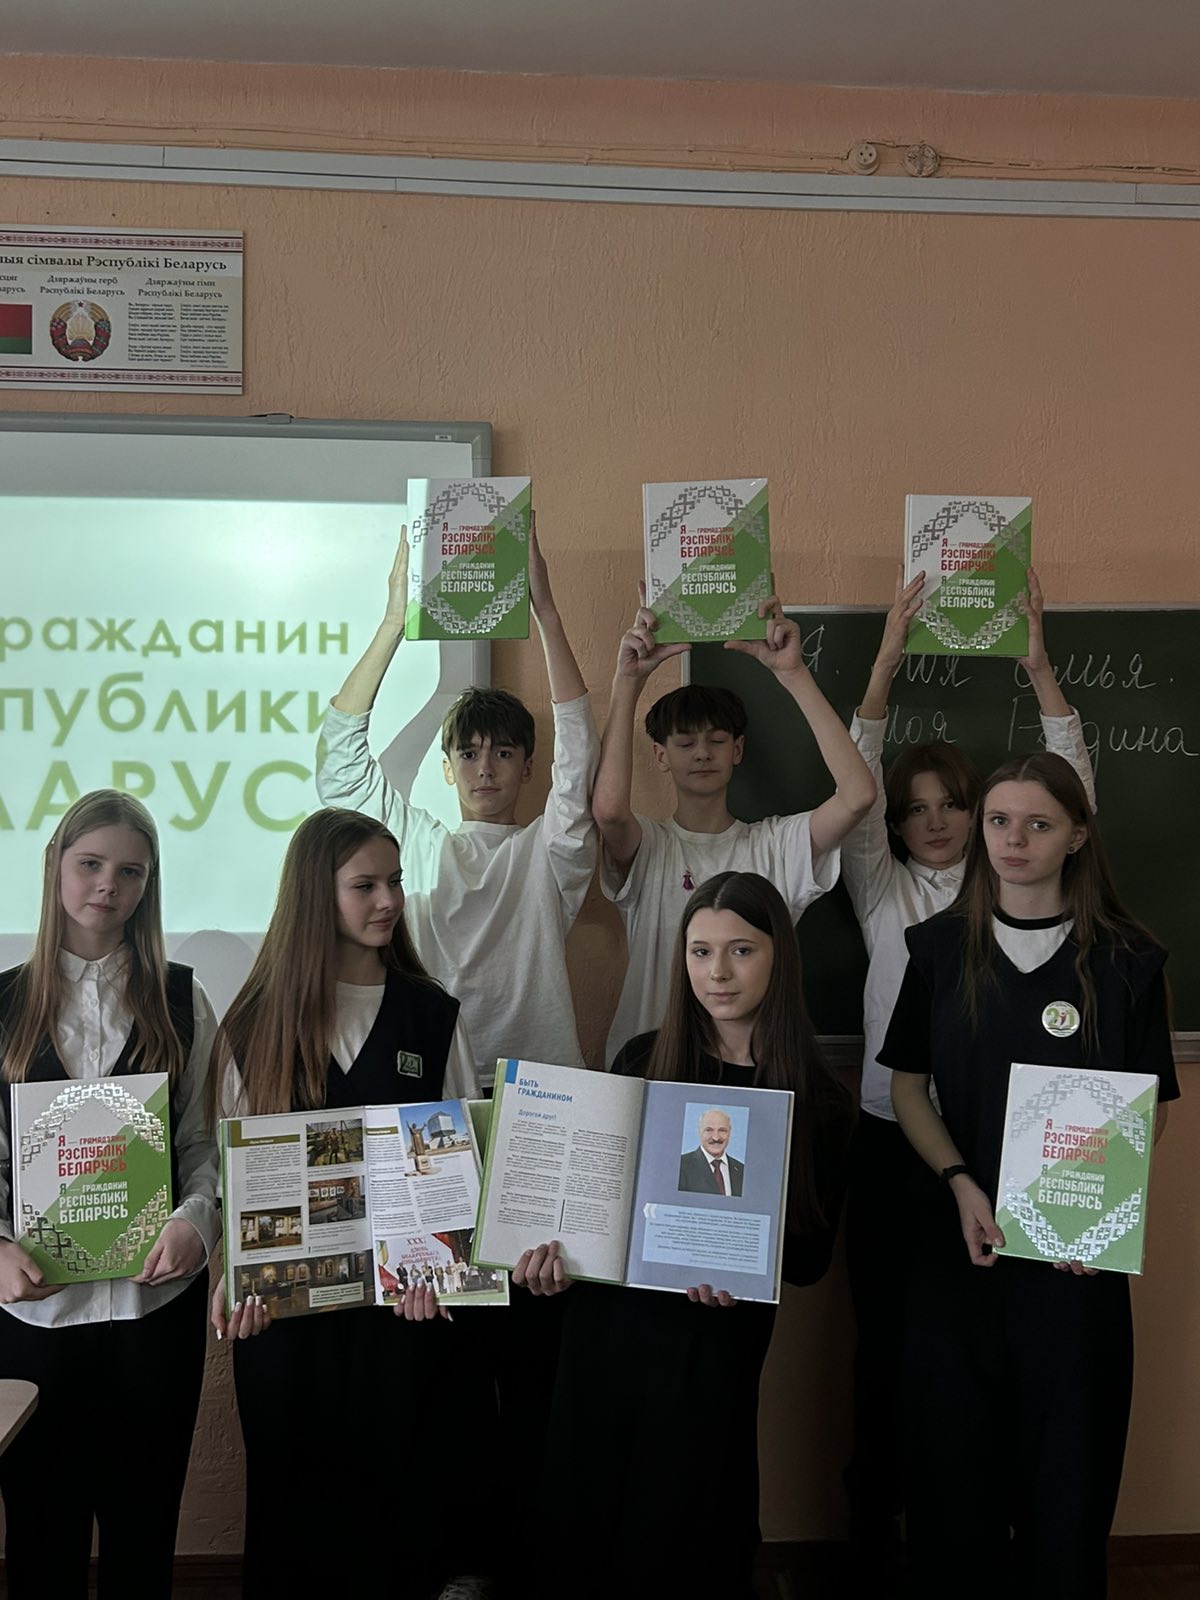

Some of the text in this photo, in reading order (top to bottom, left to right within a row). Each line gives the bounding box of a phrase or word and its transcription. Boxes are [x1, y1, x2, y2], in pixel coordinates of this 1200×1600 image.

[27, 254, 83, 268] сімвалы
[87, 255, 159, 271] Рэспублікі
[164, 257, 227, 272] Беларусь
[98, 276, 118, 285] герб
[40, 286, 125, 297] Рэспублікі Беларусь
[138, 289, 223, 300] Рэспублікі Беларусь
[442, 522, 449, 532] Я
[680, 525, 687, 535] Я
[941, 538, 948, 548] Я
[441, 544, 496, 556] БЕЛАРУСЬ
[681, 546, 736, 558] БЕЛАРУСЬ
[441, 560, 448, 569] Я
[681, 563, 688, 572] Я
[941, 560, 996, 572] БЕЛАРУСЬ
[441, 570, 495, 581] РЕСПУБЛИКИ
[681, 572, 737, 582] РЕСПУБЛИКИ
[941, 576, 947, 585] Я
[440, 581, 495, 593] БЕЛАРУСЬ
[682, 582, 737, 595] БЕЛАРУСЬ
[940, 586, 995, 597] РЕСПУБЛИКИ
[940, 597, 995, 609] БЕЛАРУСЬ
[0, 616, 349, 662] ражданин
[1014, 653, 1174, 689] смья.
[1008, 693, 1200, 781] Рдина
[0, 759, 313, 832] АРУС
[519, 1078, 539, 1088] БЫТЬ
[518, 1087, 573, 1103] ГРАЖДАНИНОМ
[1045, 1118, 1053, 1130] Я
[58, 1135, 66, 1147] Я
[1042, 1145, 1106, 1165] БЕЛАРУСЬ
[58, 1159, 127, 1177] БЕЛАРУСЬ
[1041, 1164, 1048, 1175] Я
[59, 1183, 67, 1195] Я
[82, 1181, 128, 1192] ГРАЖДАНИН
[1039, 1176, 1105, 1195] РЕСПУБЛИКИ
[59, 1191, 128, 1208] РЕСПУБЛИКИ
[1038, 1190, 1103, 1210] БЕЛАРУСЬ
[60, 1206, 129, 1224] БЕЛАРУСЬ
